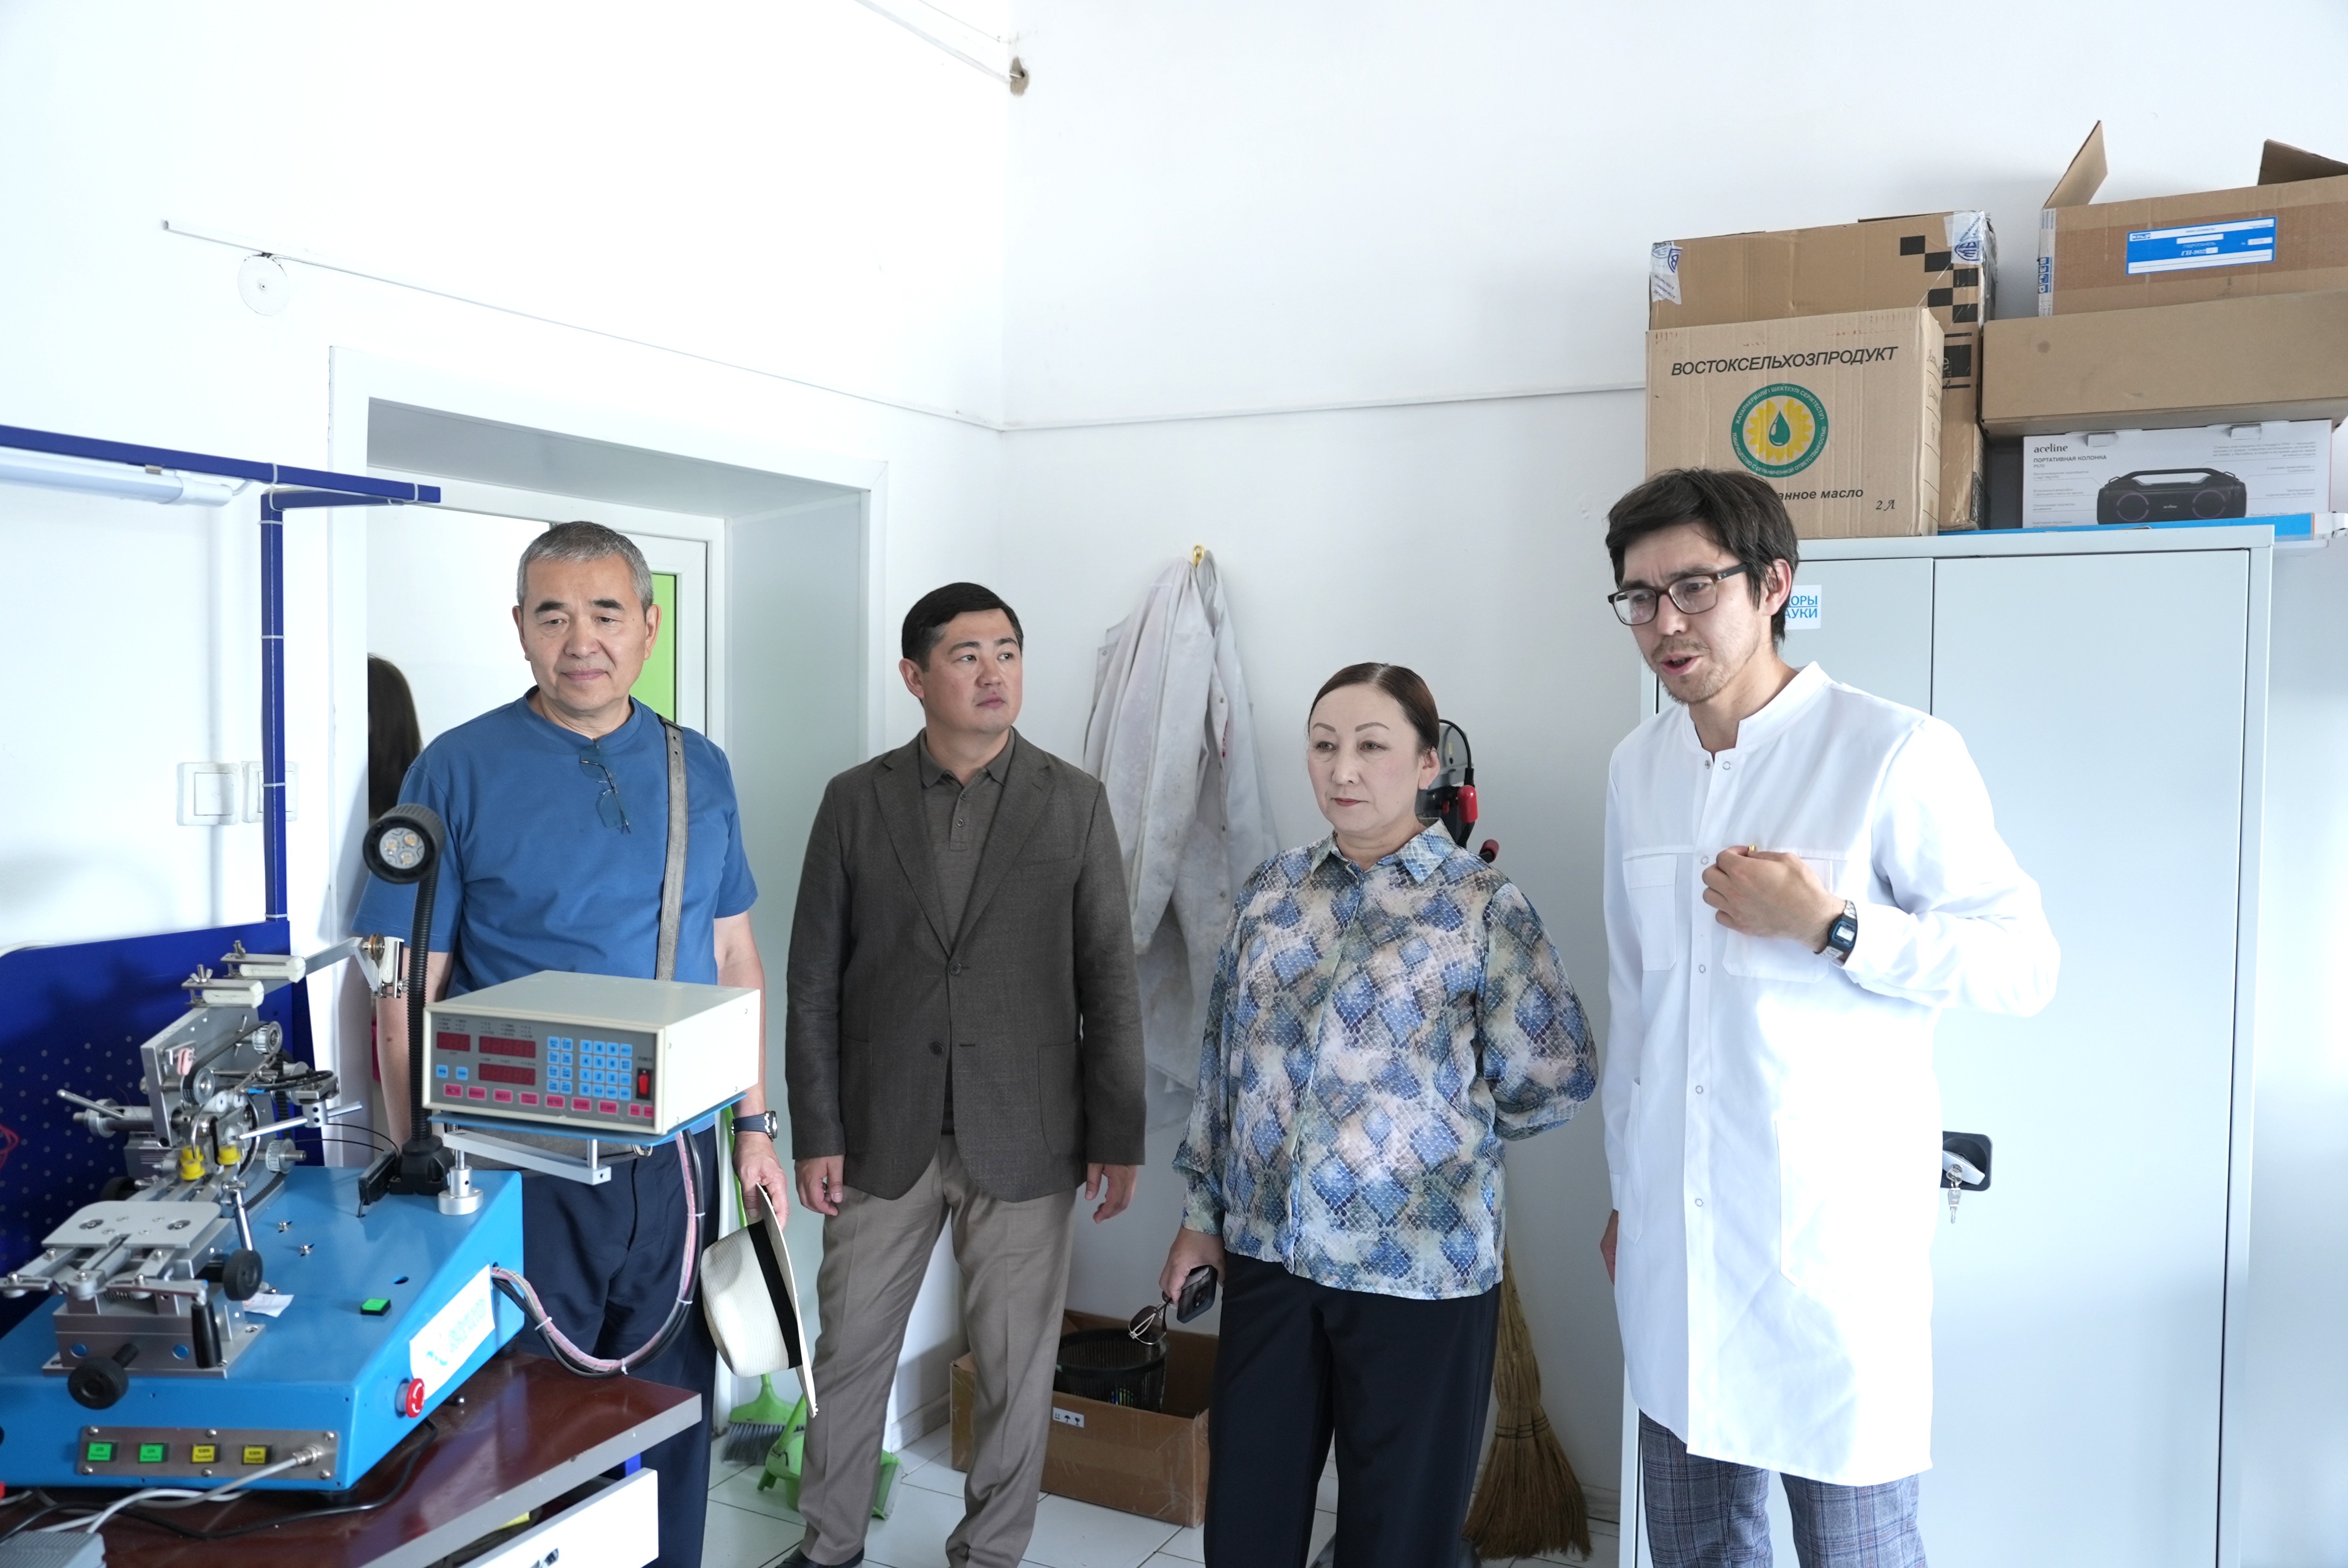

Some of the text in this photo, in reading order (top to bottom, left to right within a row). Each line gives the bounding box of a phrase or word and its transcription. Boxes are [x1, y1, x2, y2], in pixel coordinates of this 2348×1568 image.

[1671, 346, 1899, 376] ВОСТОКСЕЛЬХОЗПРОДУКТ
[2034, 443, 2068, 453] aceline
[1778, 489, 1863, 501] анное масло
[1875, 500, 1883, 510] 2
[1790, 595, 1817, 606] ОРЫ
